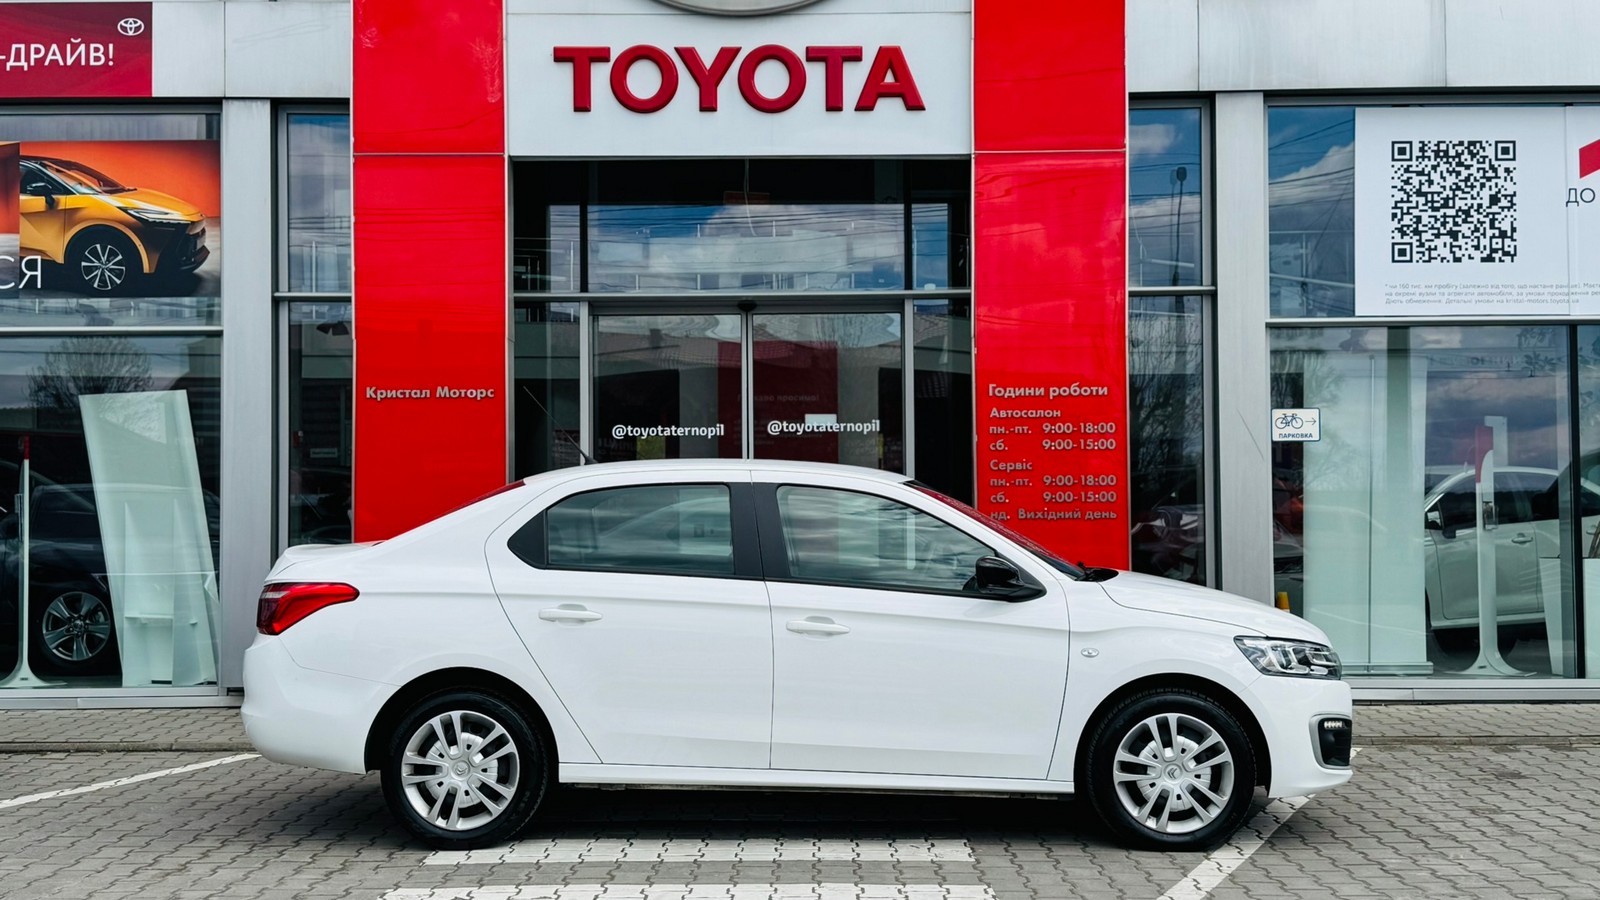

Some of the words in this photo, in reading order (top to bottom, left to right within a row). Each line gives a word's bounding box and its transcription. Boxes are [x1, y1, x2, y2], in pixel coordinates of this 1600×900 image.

[553, 44, 926, 114] TOYOTA
[1565, 187, 1596, 207] ДО
[365, 386, 430, 401] Кристал
[436, 386, 494, 400] Моторс
[989, 384, 1044, 399] Години
[1049, 382, 1108, 399] роботи
[990, 407, 1061, 418] Автосалон
[611, 423, 725, 440] @toyotaternopil
[767, 419, 881, 436] @toyotaternopil
[989, 424, 1032, 434] пн.-пт.
[990, 439, 1008, 451] сб.
[989, 458, 1032, 472] Сервіс
[990, 476, 1033, 486] пн.-пт.
[990, 491, 1009, 503] сб.
[991, 510, 1010, 520] нд.
[1018, 507, 1081, 520] Вихідний
[1085, 509, 1117, 520] день
